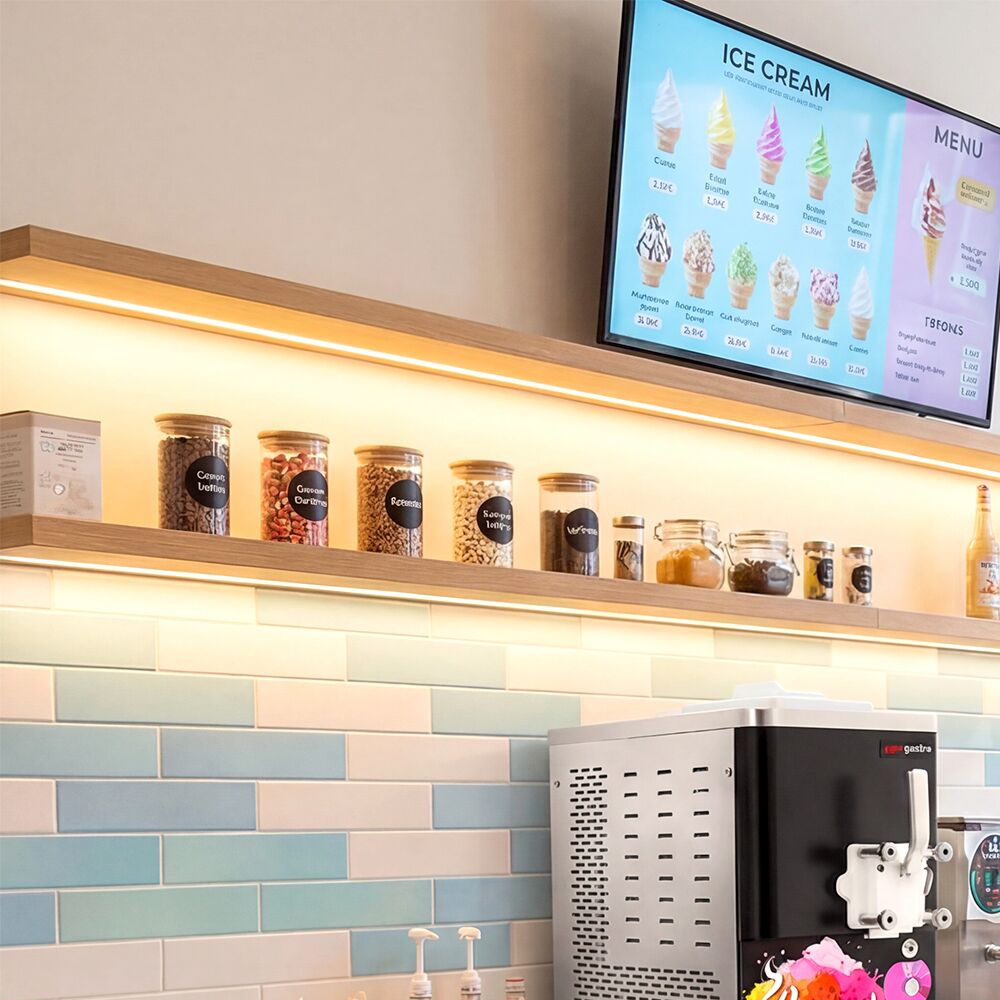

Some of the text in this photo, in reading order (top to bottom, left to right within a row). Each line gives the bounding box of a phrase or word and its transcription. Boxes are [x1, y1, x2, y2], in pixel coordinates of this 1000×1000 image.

[722, 43, 756, 74] ICE
[761, 59, 831, 102] CREAM
[934, 125, 984, 160] MENU
